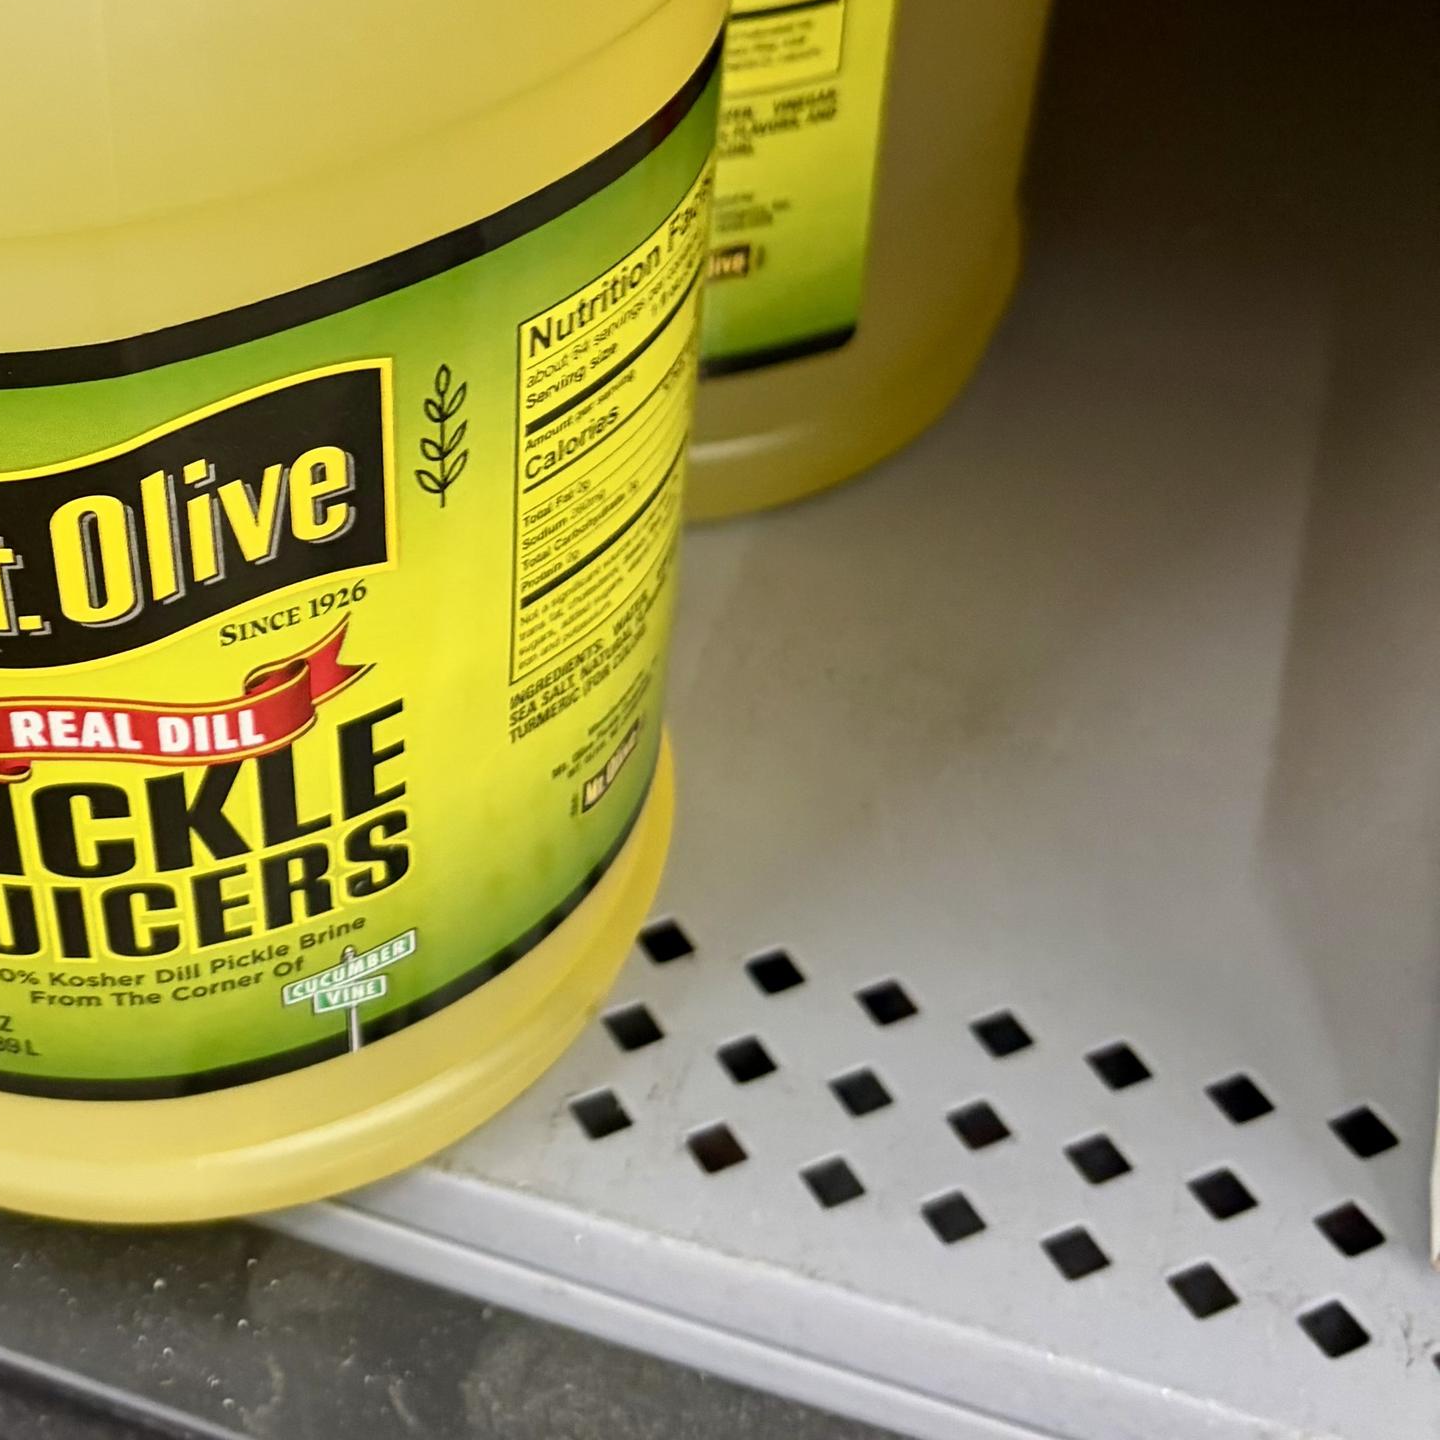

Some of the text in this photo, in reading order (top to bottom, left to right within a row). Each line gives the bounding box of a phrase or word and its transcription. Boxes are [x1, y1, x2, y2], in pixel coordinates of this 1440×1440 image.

[529, 244, 660, 358] Nutrition
[526, 353, 569, 390] about
[526, 366, 586, 410] Serving
[524, 405, 620, 480] Calories
[525, 419, 572, 452] Amount
[48, 444, 357, 628] Olive
[309, 578, 368, 629] 1926
[9, 709, 266, 752] REAL DILL
[509, 701, 537, 728] SEA
[509, 686, 581, 744] TURMERIC
[48, 971, 146, 988] Kosher
[155, 963, 201, 985] Dill
[209, 944, 290, 975] Pickle
[299, 916, 367, 951] Brine
[291, 939, 409, 998] CUCUMBER
[29, 956, 305, 1008] From The Corner Of
[325, 980, 376, 1005] VINE
[23, 1039, 42, 1057] L
